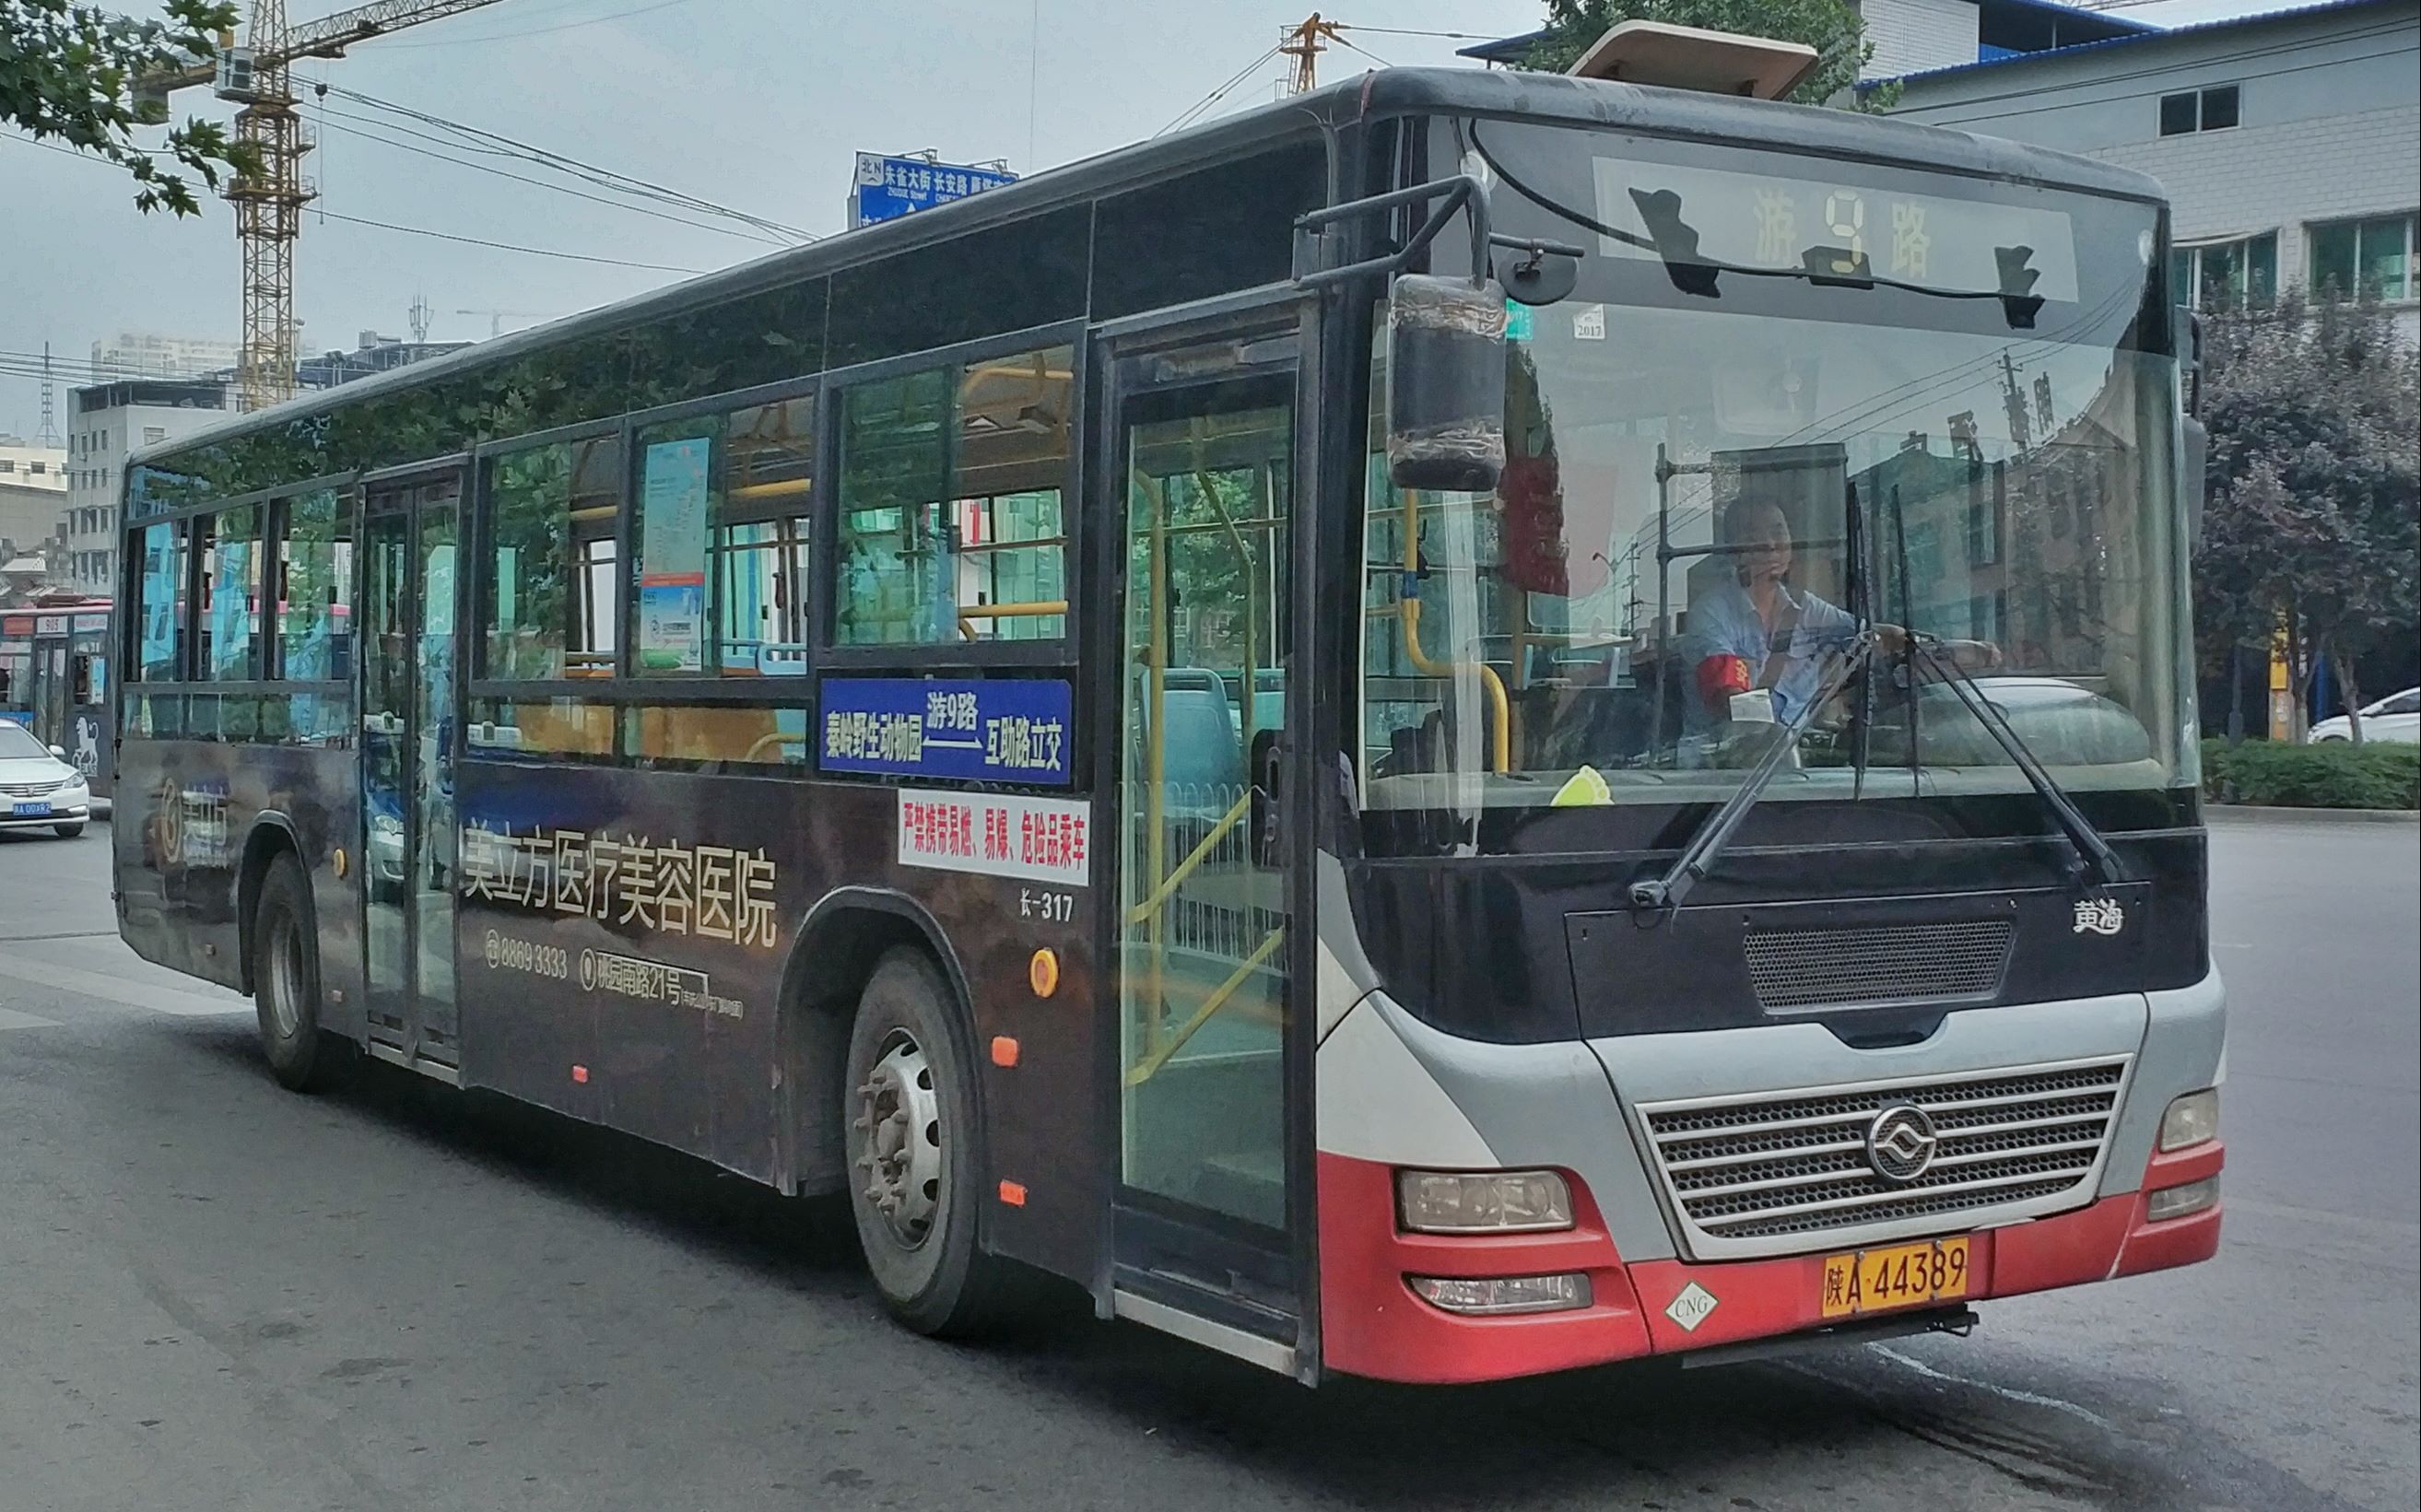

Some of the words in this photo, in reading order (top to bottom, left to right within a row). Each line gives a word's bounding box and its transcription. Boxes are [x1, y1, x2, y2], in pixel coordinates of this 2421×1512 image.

[862, 158, 872, 175] 北
[874, 162, 882, 175] N
[885, 164, 931, 191] 朱雀大街
[934, 170, 968, 196] 长安路
[1578, 324, 1602, 337] 2017
[926, 691, 980, 731] 游9路
[826, 710, 923, 763] 秦岭野生动物园
[984, 715, 1064, 771] 互助路立交
[464, 816, 776, 948] 美立方医疗美容医院
[1019, 887, 1073, 921] 长-317
[2073, 898, 2123, 935] 黄海
[500, 937, 533, 972] 8869
[535, 944, 568, 980] 3333
[1674, 1295, 1708, 1319] CNG
